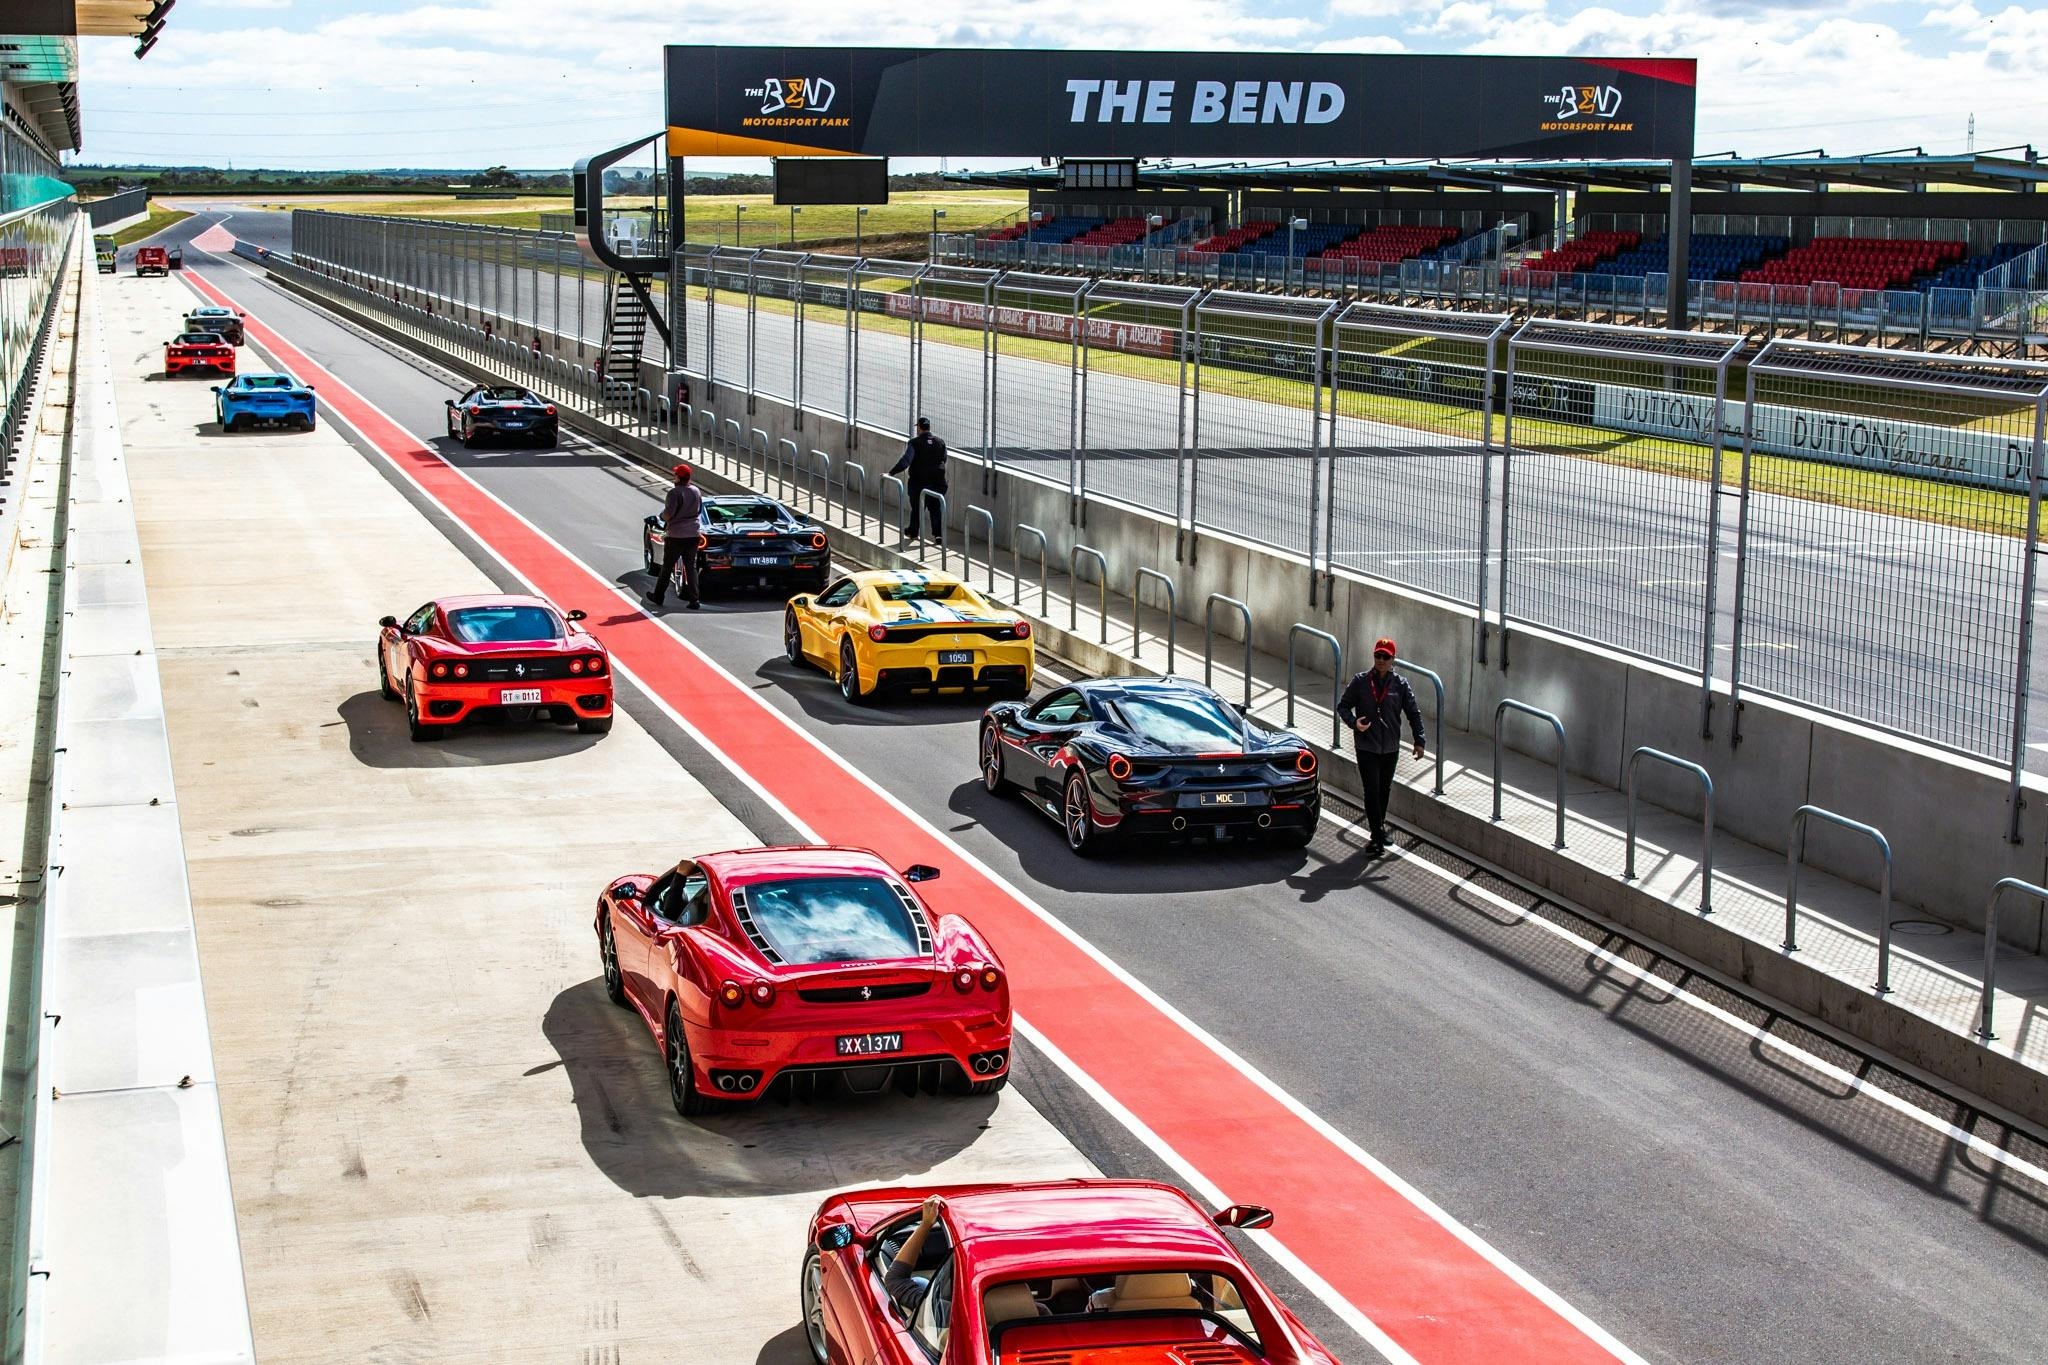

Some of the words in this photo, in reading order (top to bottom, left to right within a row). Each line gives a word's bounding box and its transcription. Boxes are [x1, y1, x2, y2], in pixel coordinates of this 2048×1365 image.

[744, 88, 764, 97] THE
[761, 77, 836, 114] BEND
[1065, 79, 1176, 123] THE
[1190, 80, 1346, 124] BEND
[1543, 95, 1561, 103] THE
[1557, 85, 1622, 119] BEND
[743, 118, 818, 127] MOTORSPORT
[820, 118, 850, 127] PARK
[1541, 122, 1606, 131] MOTORSPORT
[1608, 123, 1633, 131] PARK
[1539, 382, 1569, 413] OTR
[1624, 392, 1700, 432] DUTTON
[1793, 416, 1891, 461] DUTTON
[949, 653, 967, 663] 1050
[503, 693, 513, 702] RT
[522, 692, 540, 701] 0112
[1216, 793, 1234, 803] MDC
